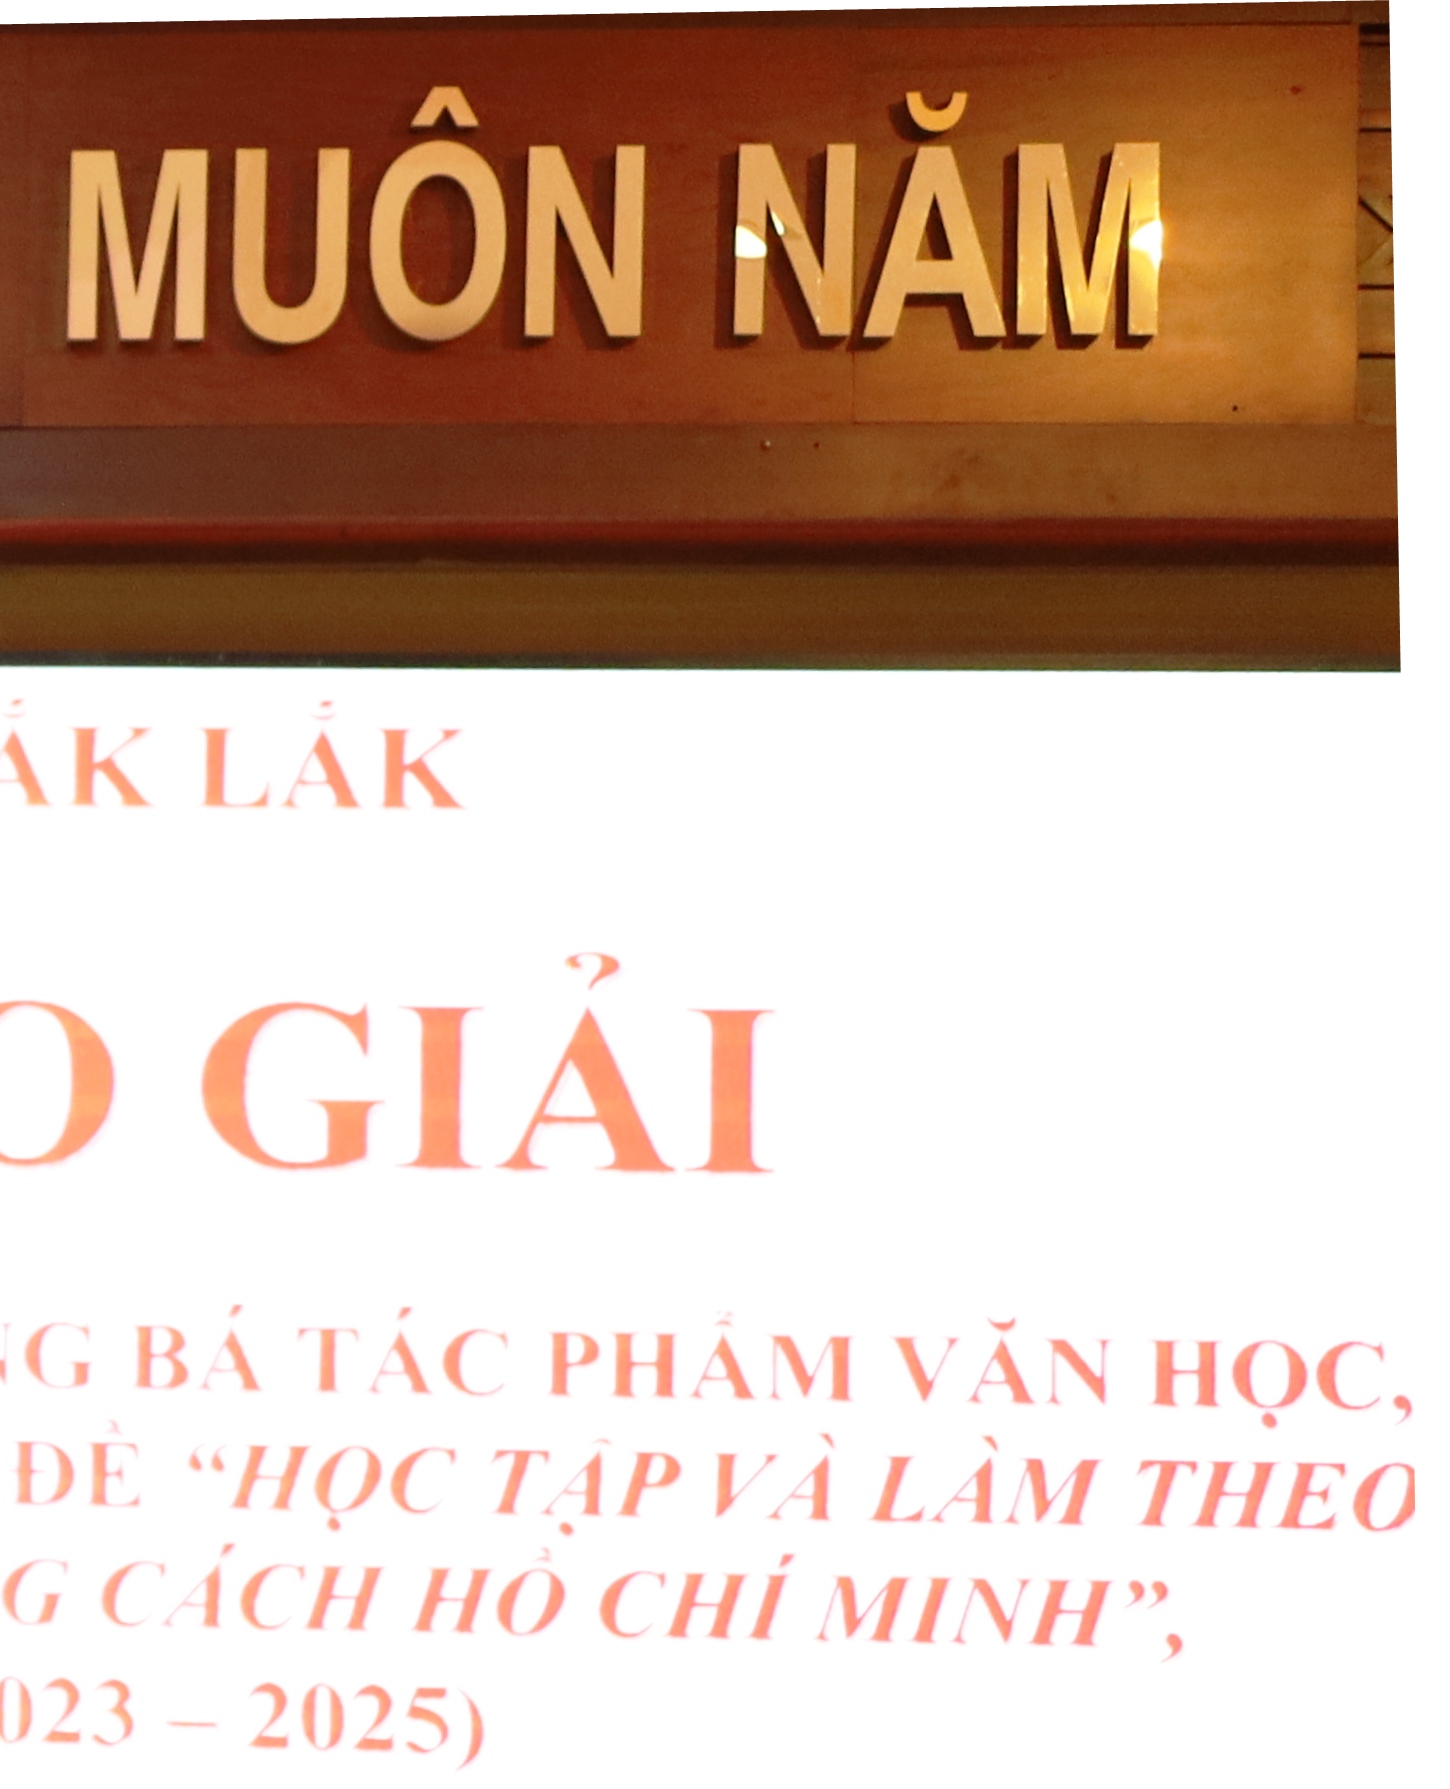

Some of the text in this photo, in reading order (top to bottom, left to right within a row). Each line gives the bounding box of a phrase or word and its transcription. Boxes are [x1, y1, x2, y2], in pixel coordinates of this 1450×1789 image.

[65, 86, 647, 346] MUÔN
[733, 89, 1163, 343] NĂM
[203, 701, 461, 809] LẮK
[201, 953, 771, 1174] GIẢI
[136, 1305, 260, 1392] BÁ
[298, 1307, 507, 1396] TÁC
[551, 1311, 850, 1402] PHẨM
[895, 1319, 1109, 1405] VĂN
[1153, 1340, 1412, 1429] HỌC,
[17, 1420, 139, 1506] ĐỀ
[189, 1445, 456, 1532] “HỌC
[494, 1440, 681, 1536] TẬP
[716, 1433, 834, 1521] VÀ
[872, 1435, 1100, 1525] LÀM
[1138, 1460, 1415, 1532] THEO
[102, 1543, 382, 1630] CÁCH
[414, 1549, 566, 1635] HỒ
[599, 1554, 794, 1640] CHÍ
[817, 1576, 1183, 1658] MINH”,
[250, 1682, 484, 1767] 2025)
